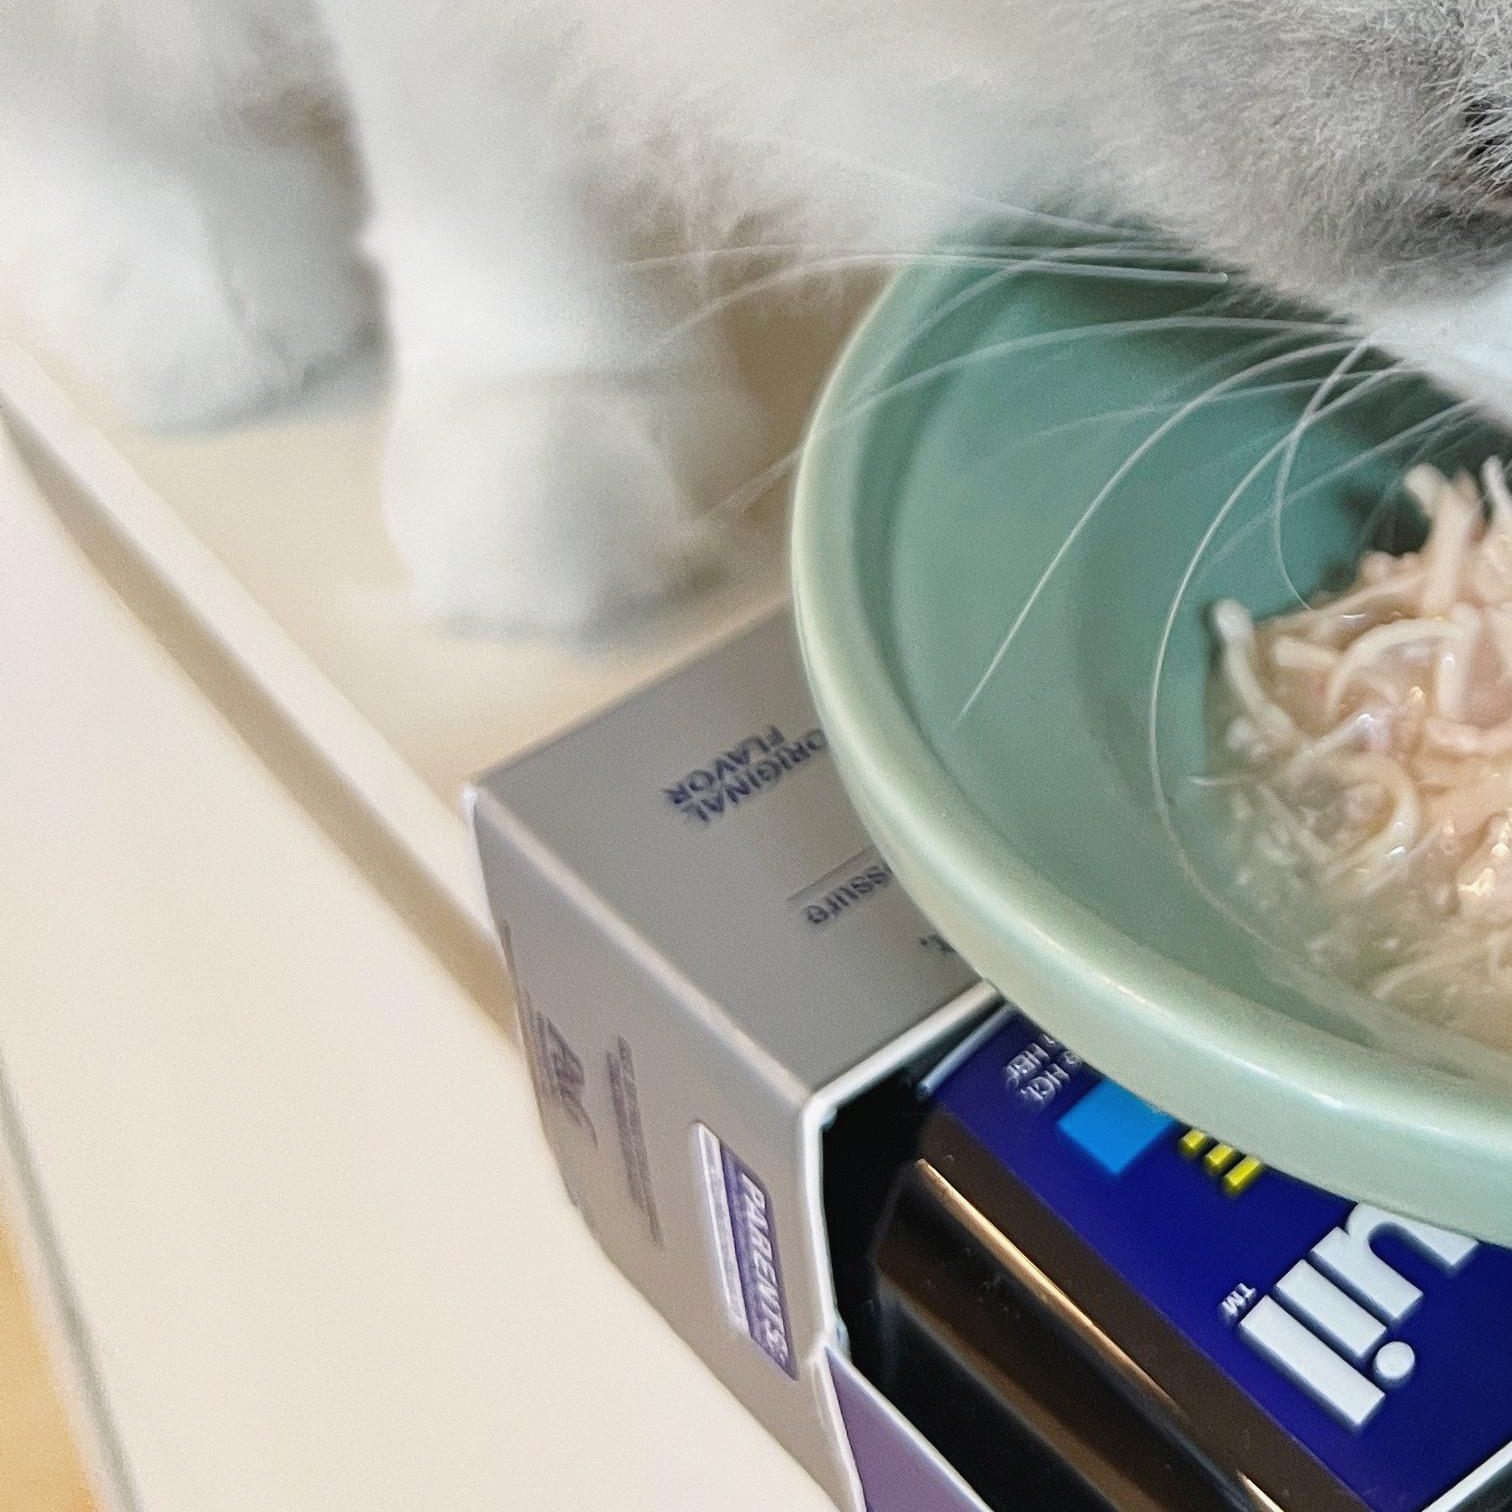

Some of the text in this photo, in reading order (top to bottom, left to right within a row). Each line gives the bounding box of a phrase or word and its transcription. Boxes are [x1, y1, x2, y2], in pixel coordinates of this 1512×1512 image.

[663, 724, 785, 805] FLAVOR
[806, 864, 893, 925] ssure
[741, 1171, 790, 1355] PARENTS
[1238, 1201, 1480, 1426] uil
